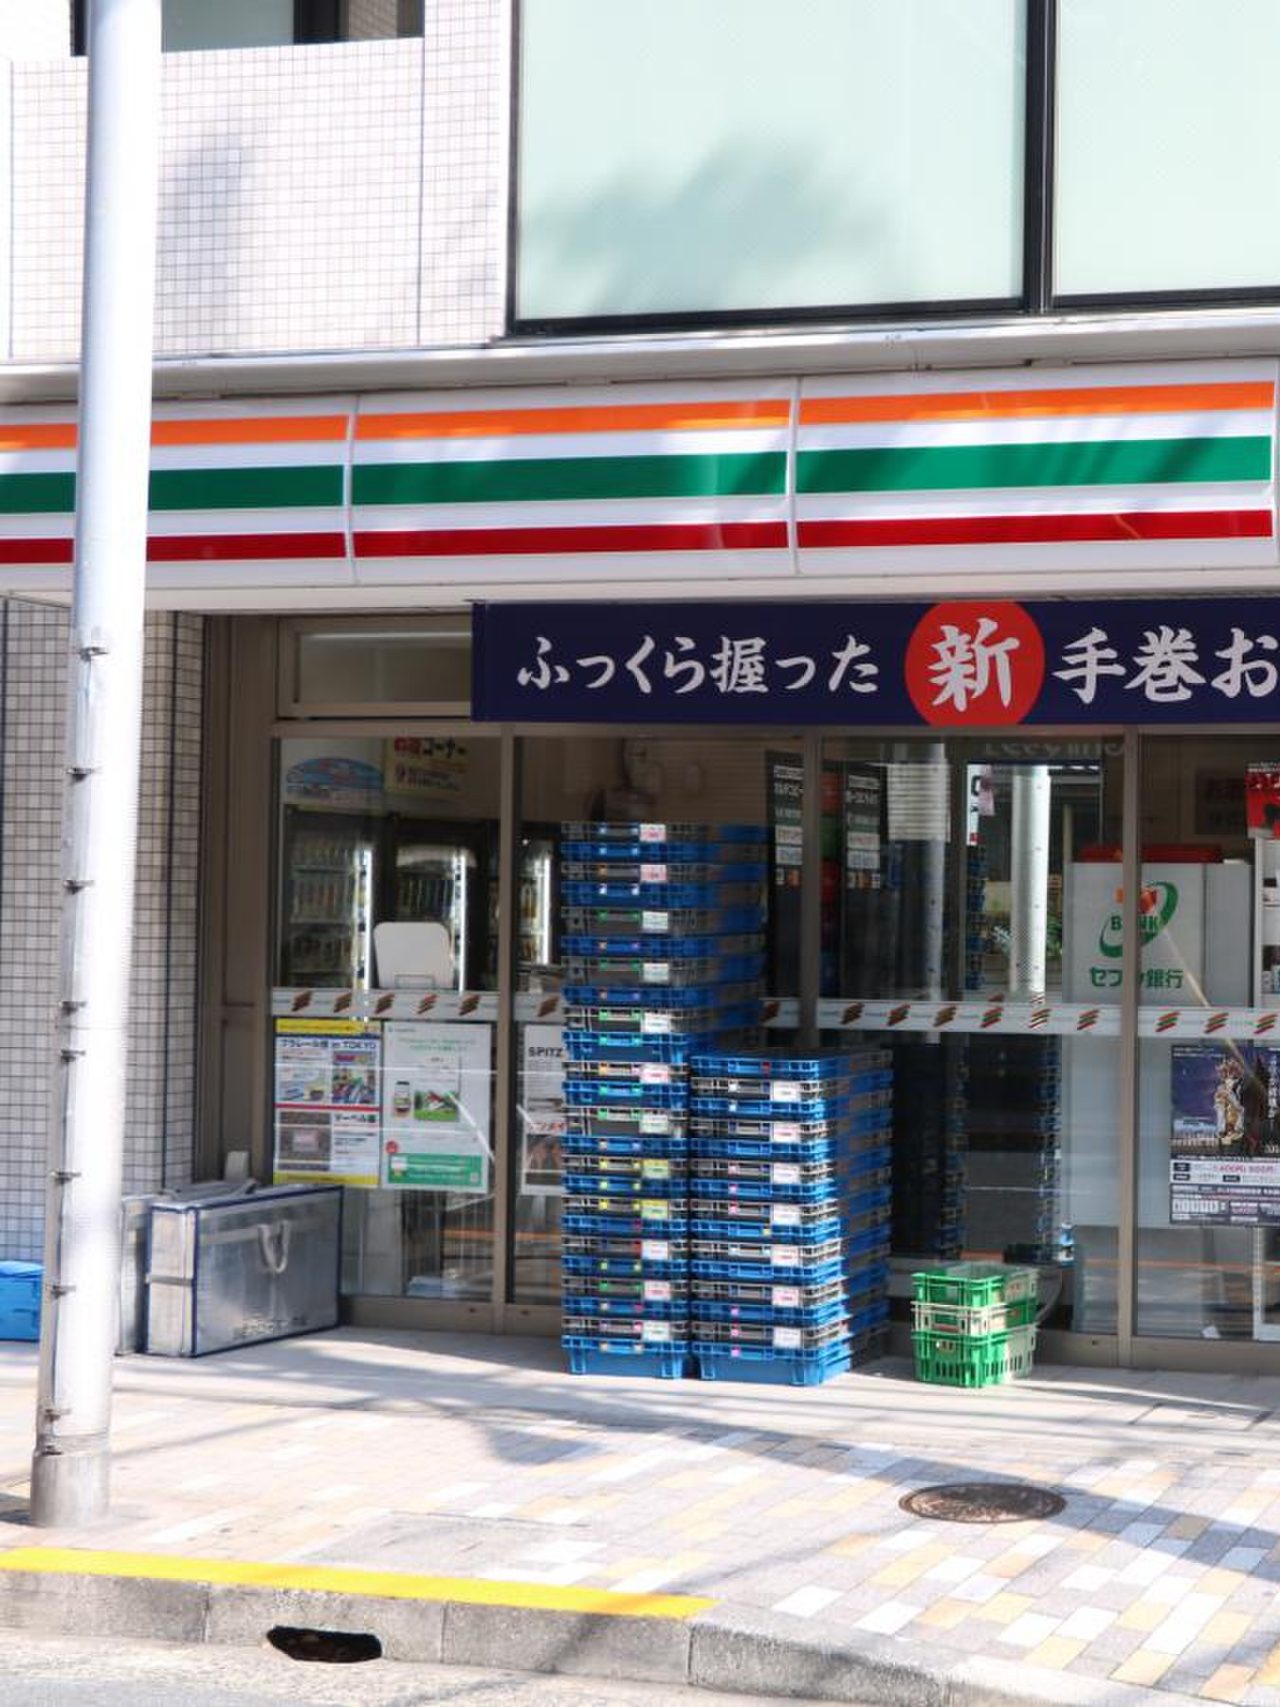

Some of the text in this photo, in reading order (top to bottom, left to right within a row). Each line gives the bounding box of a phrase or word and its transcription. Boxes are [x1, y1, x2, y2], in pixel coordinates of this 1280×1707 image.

[516, 635, 880, 695] ふっくら握った
[930, 617, 1020, 712] 新
[1111, 915, 1158, 931] BNK
[1090, 967, 1184, 989] セブ銀行
[528, 1046, 563, 1058] SPITZ
